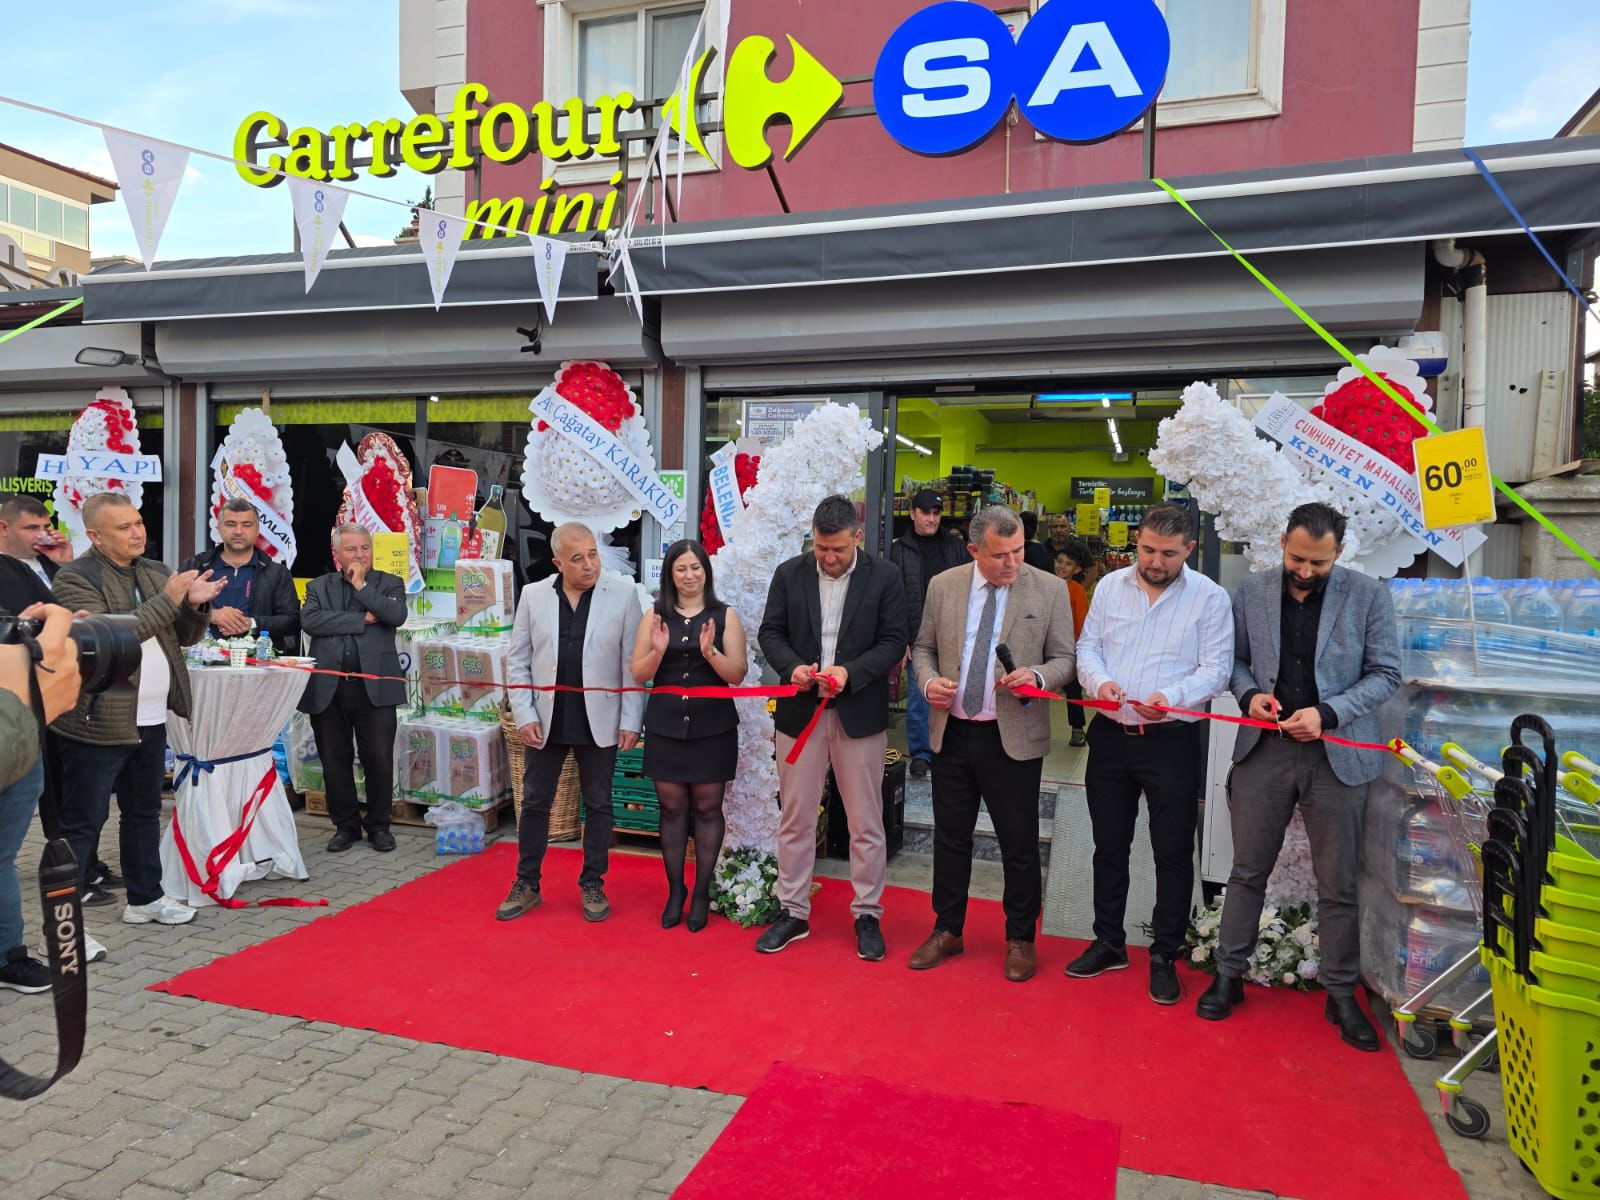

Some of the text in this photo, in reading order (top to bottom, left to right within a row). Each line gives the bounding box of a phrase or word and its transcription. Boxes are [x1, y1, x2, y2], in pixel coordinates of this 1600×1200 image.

[233, 21, 1143, 189] Carrefour SA
[463, 170, 623, 240] mini
[79, 456, 158, 475] YAPI
[553, 404, 605, 450] Çağatay
[605, 443, 679, 520] KARAKUŞ
[1295, 419, 1363, 464] CUMHURİYET
[1425, 461, 1462, 491] 60
[1288, 435, 1444, 546] KENAN DİKEN
[53, 902, 78, 976] SONY
